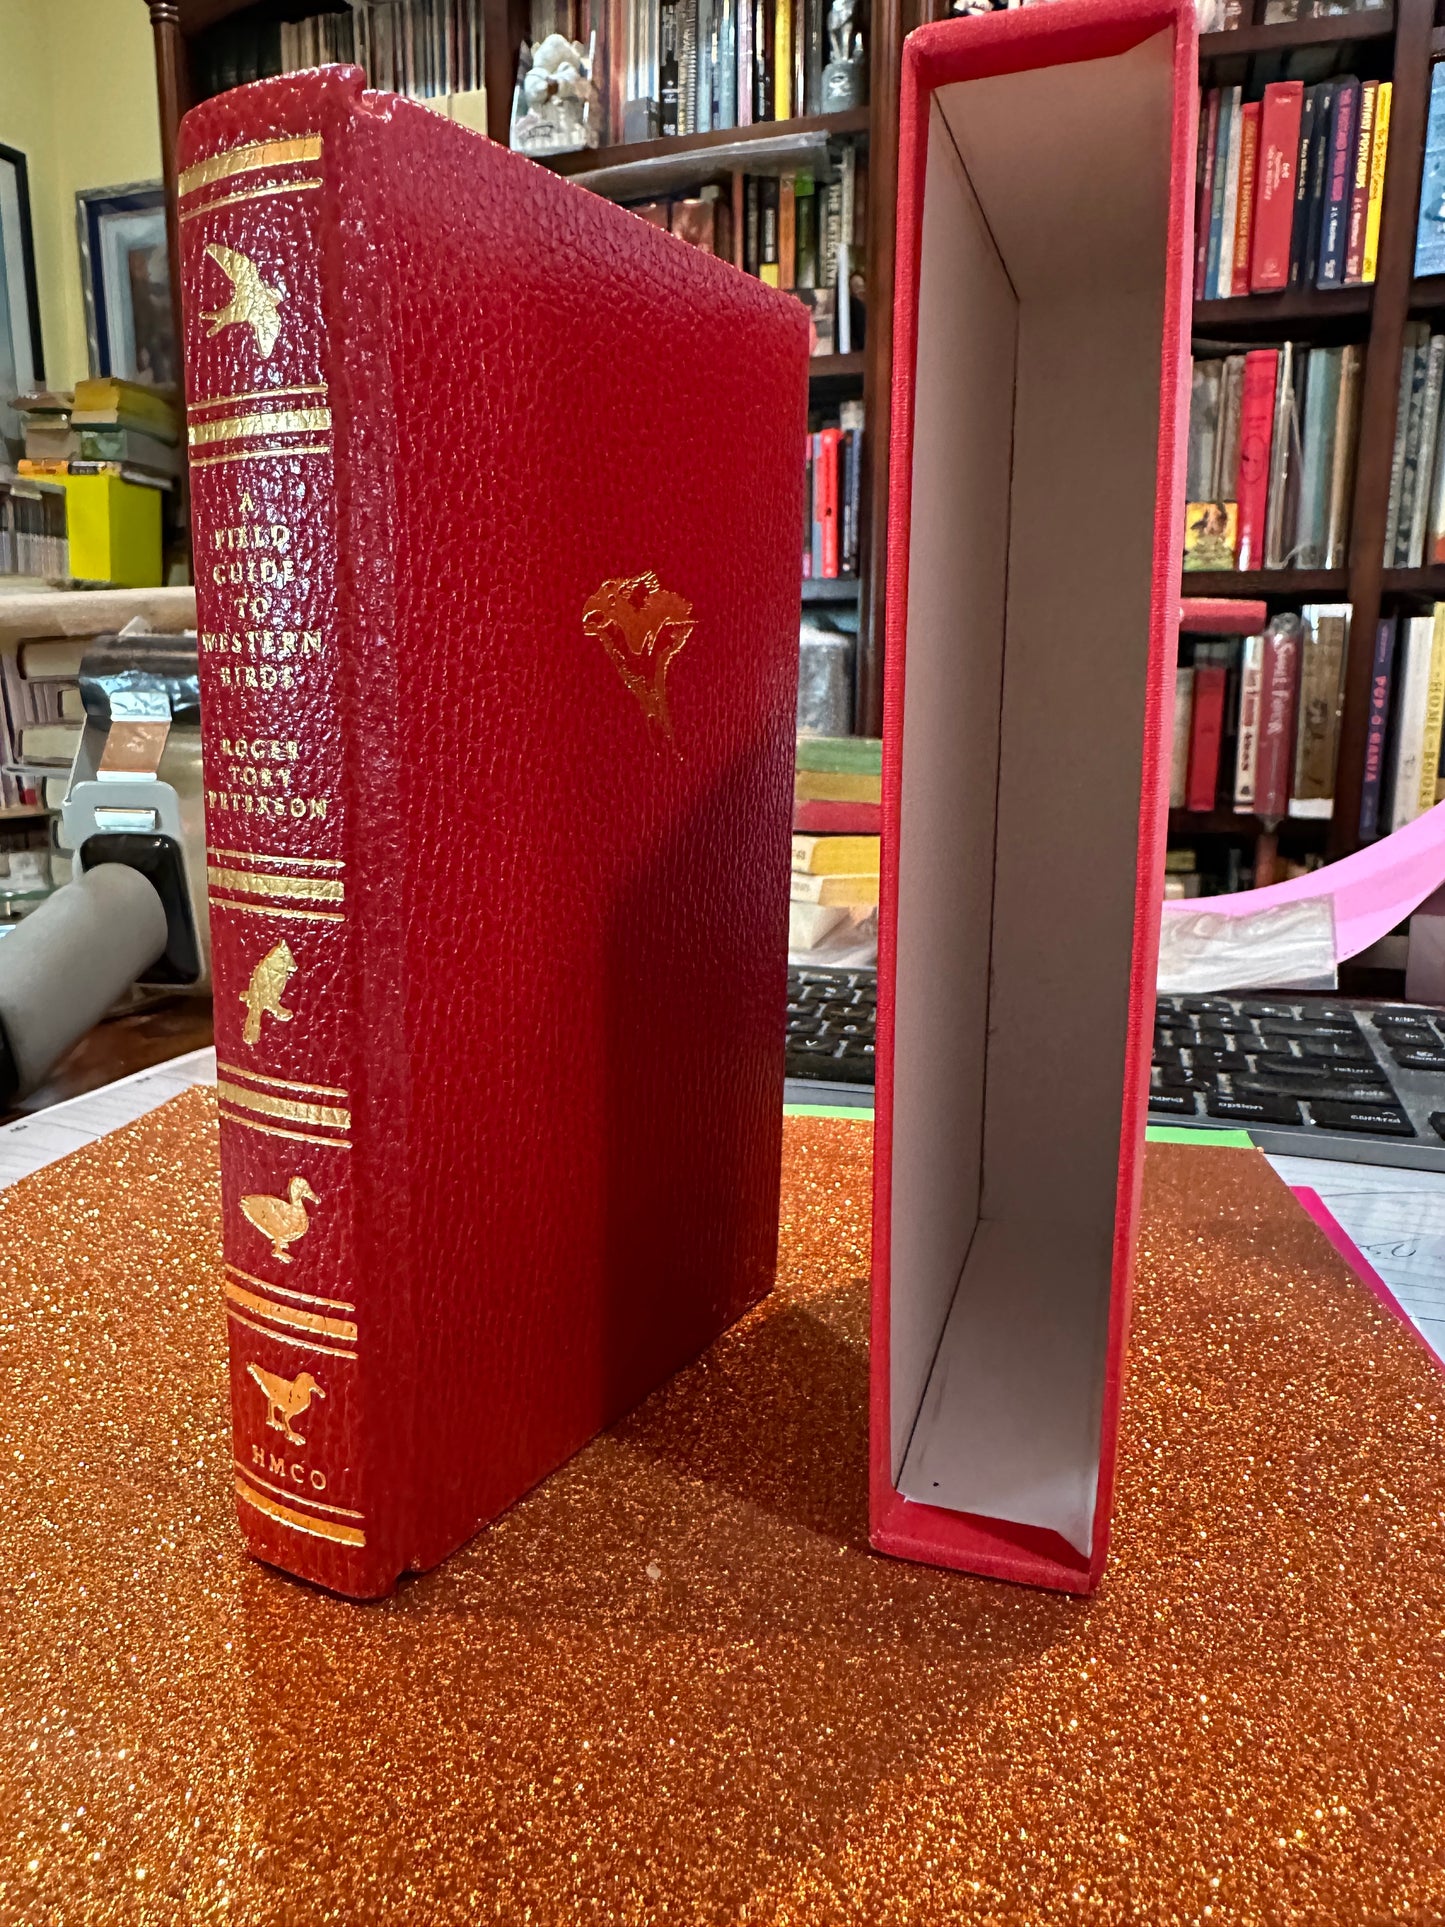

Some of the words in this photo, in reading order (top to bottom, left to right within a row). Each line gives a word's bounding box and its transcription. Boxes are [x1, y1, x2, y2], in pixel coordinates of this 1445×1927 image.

[239, 492, 255, 513] A
[215, 525, 290, 550] FIELD
[213, 558, 295, 585] GUIDE
[234, 596, 269, 619] TO
[202, 630, 323, 654] WESTERN
[220, 665, 294, 690] BIRDS
[221, 737, 299, 760] ROGER
[228, 766, 291, 787] TORY
[208, 790, 328, 821] PETERSON
[1218, 1101, 1264, 1111] option
[1350, 1114, 1401, 1123] control
[252, 1443, 327, 1490] HMCO
